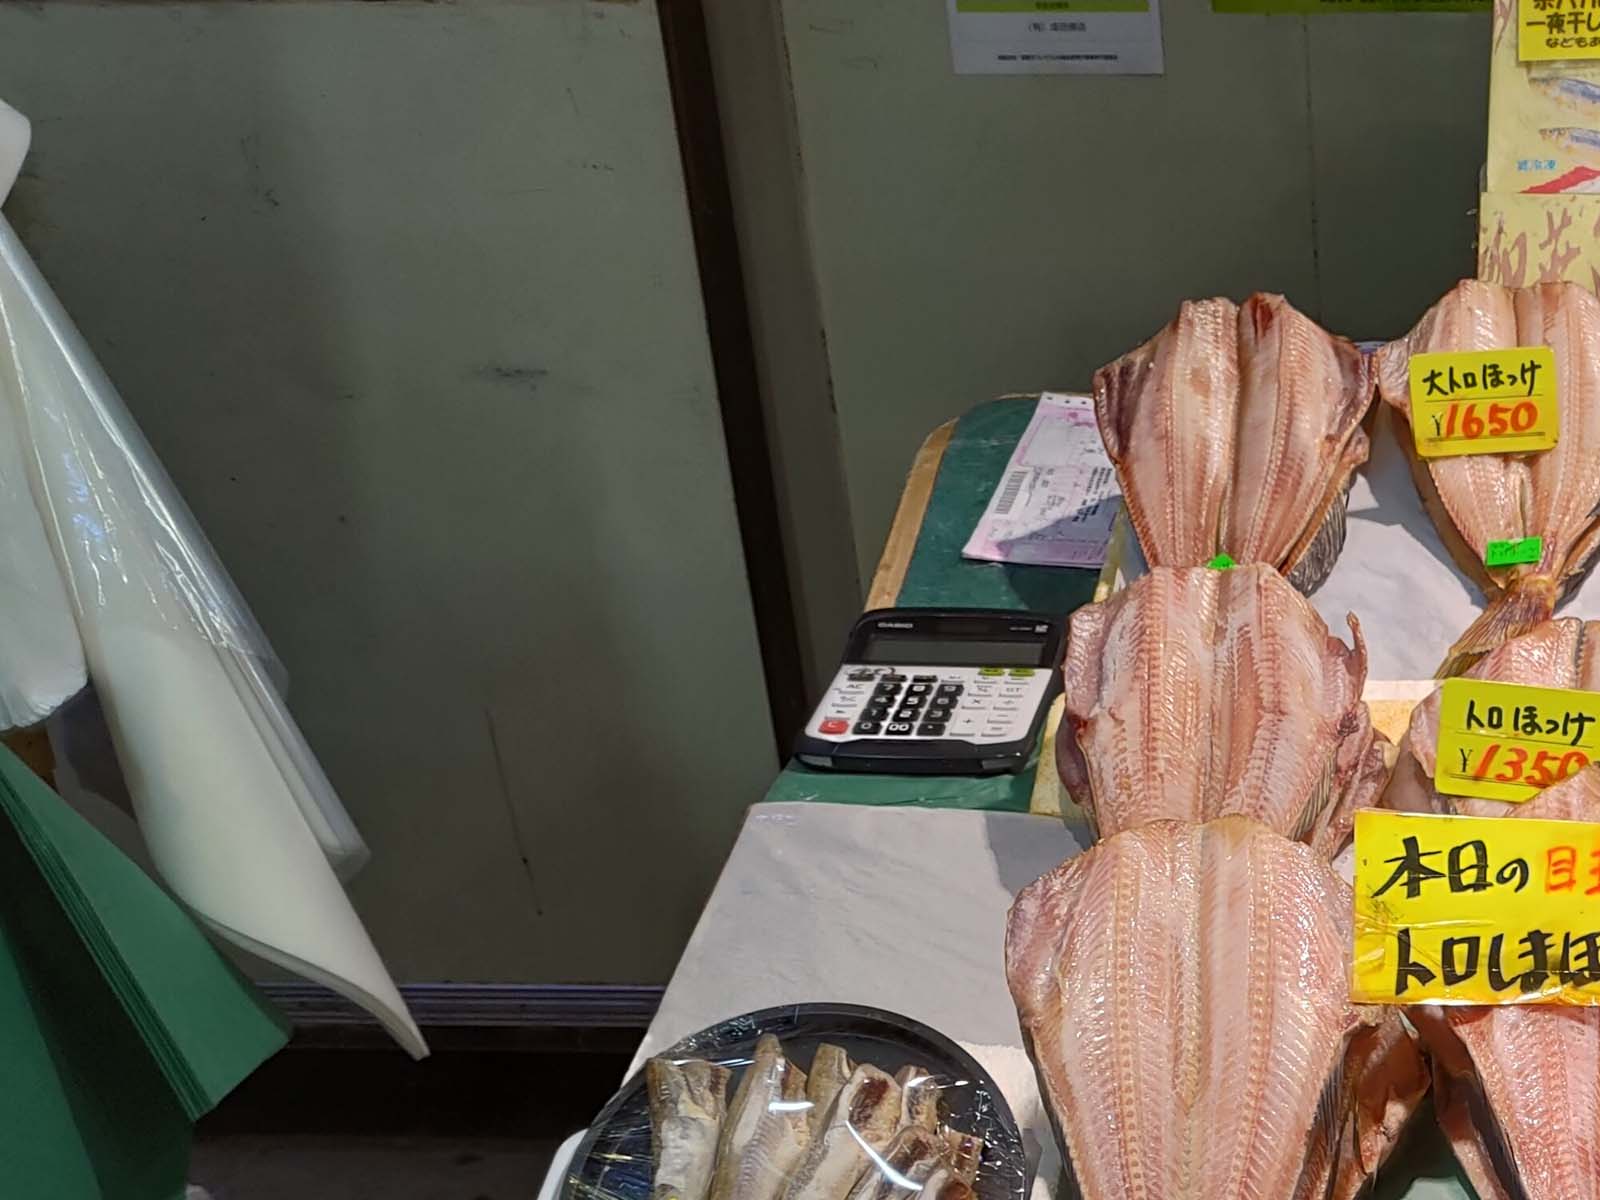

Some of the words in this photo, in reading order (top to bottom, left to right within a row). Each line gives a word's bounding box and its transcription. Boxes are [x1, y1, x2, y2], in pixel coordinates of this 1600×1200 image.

[1422, 360, 1543, 397] 大トロほっけ
[1466, 699, 1597, 746] トロほっけ
[1371, 836, 1529, 898] 本日の
